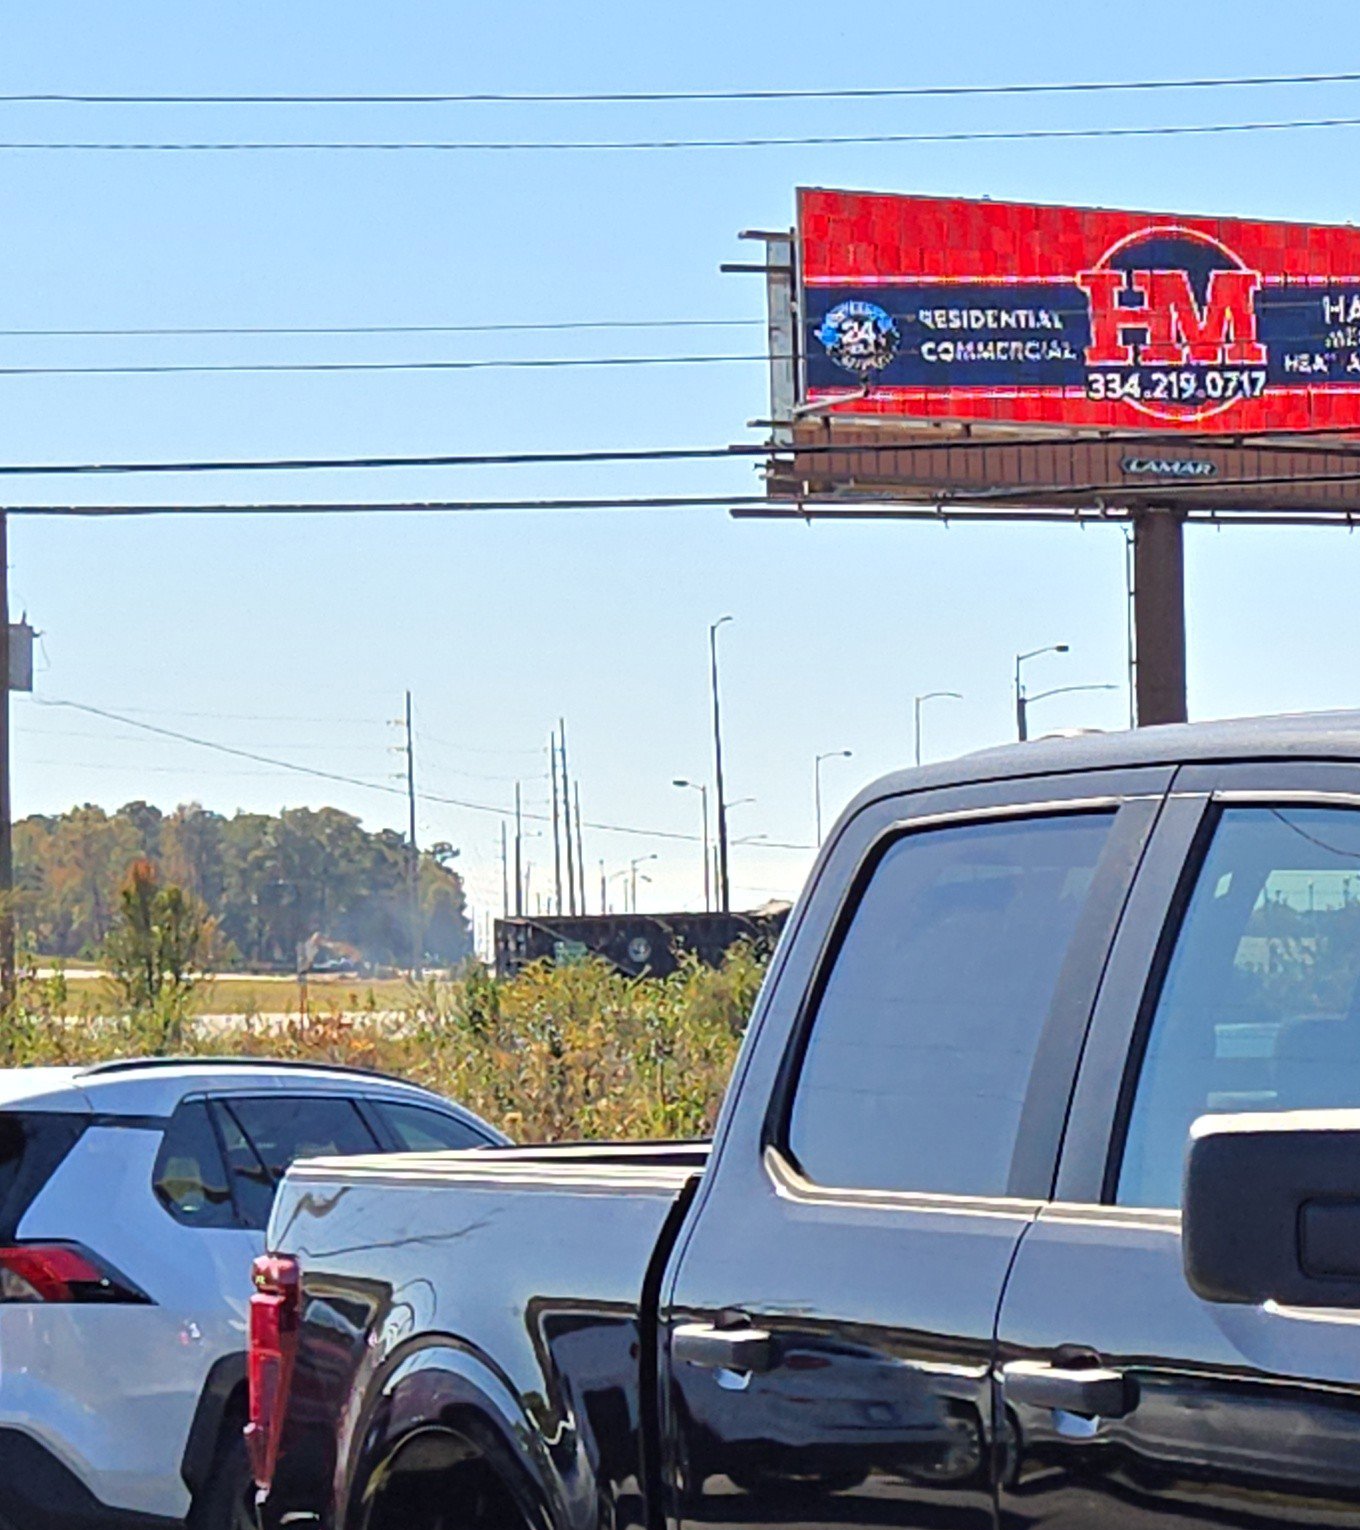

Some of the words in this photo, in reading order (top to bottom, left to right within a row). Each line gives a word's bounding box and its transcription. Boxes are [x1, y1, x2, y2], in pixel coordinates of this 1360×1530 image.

[919, 308, 1064, 331] RESIDENTIAL
[1076, 269, 1268, 365] HM
[841, 319, 877, 352] 24
[921, 340, 1078, 362] COMMERCIAL
[1087, 370, 1267, 399] 334.219.0717
[1129, 458, 1212, 475] LAMAR
